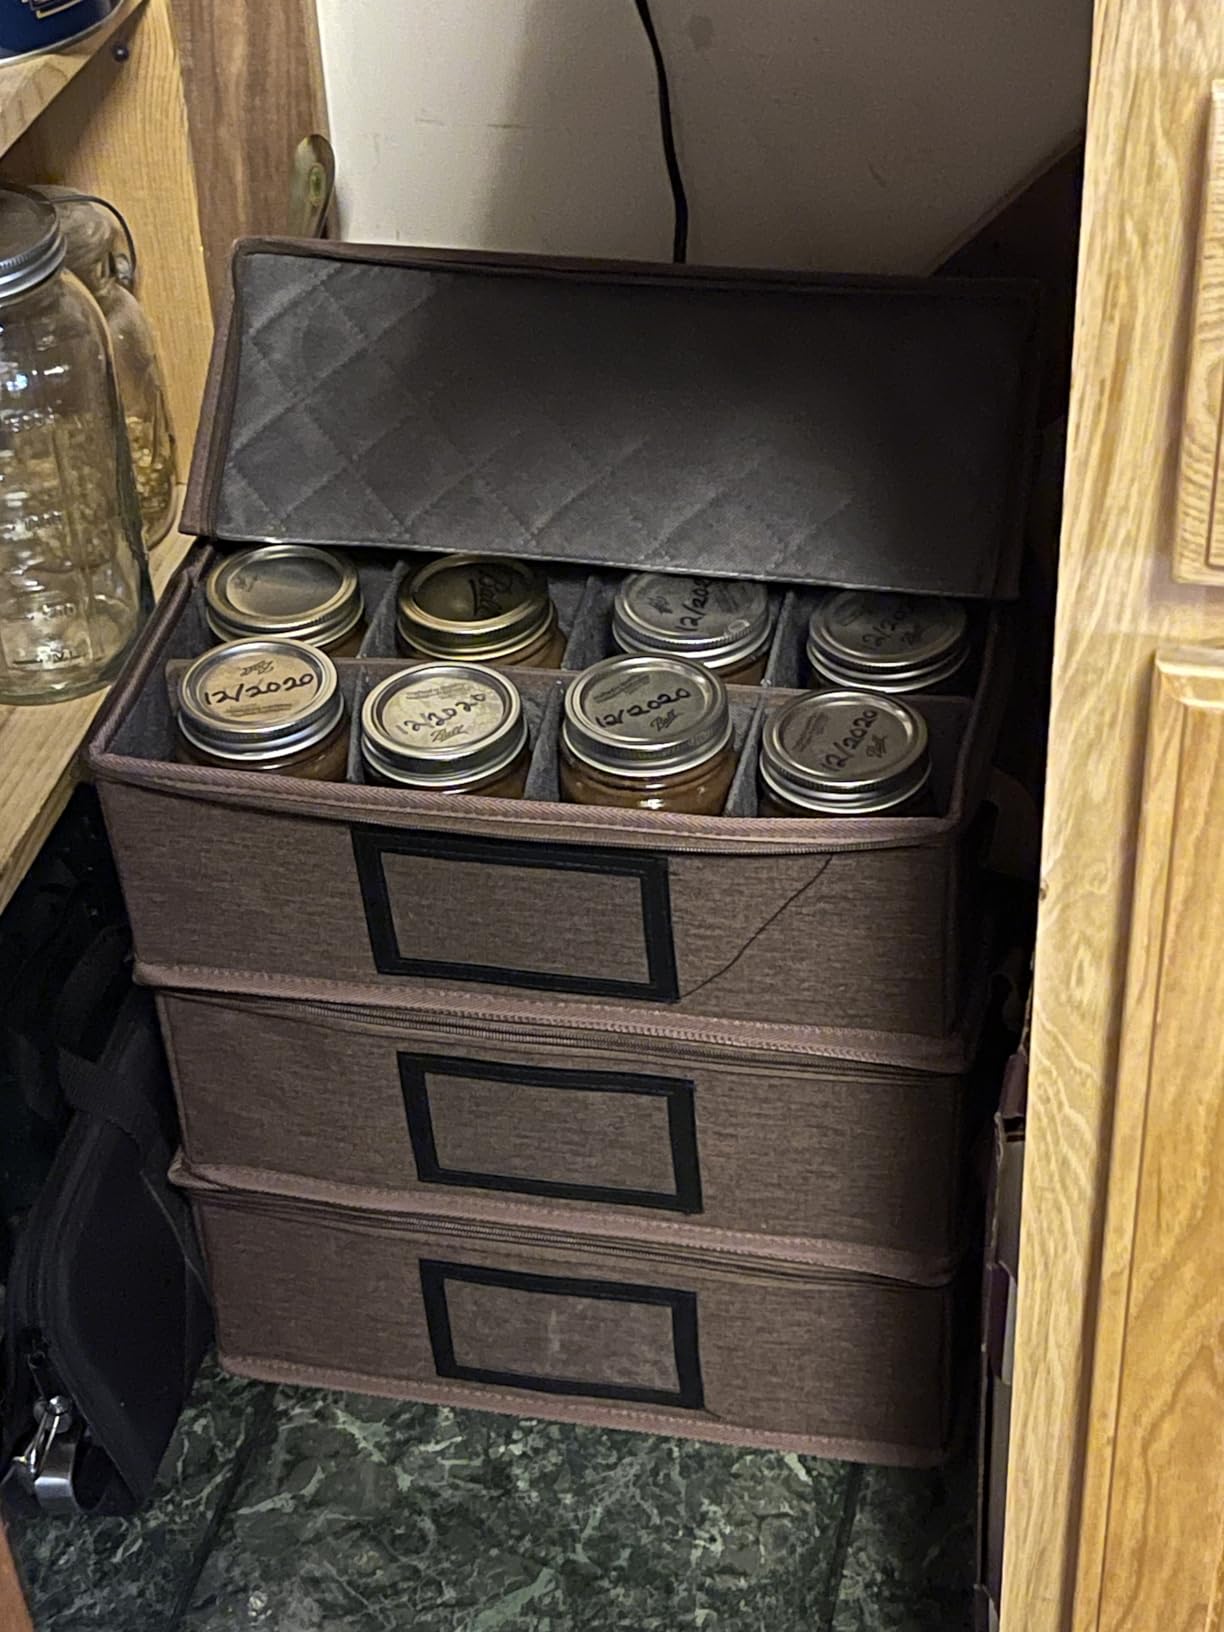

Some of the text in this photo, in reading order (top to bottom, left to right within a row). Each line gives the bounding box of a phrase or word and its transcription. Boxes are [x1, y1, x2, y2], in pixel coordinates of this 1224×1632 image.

[204, 673, 314, 705] 12/2020
[595, 687, 691, 728] 12/2020
[395, 693, 486, 735] 12/2020
[820, 708, 879, 772] 12/2020
